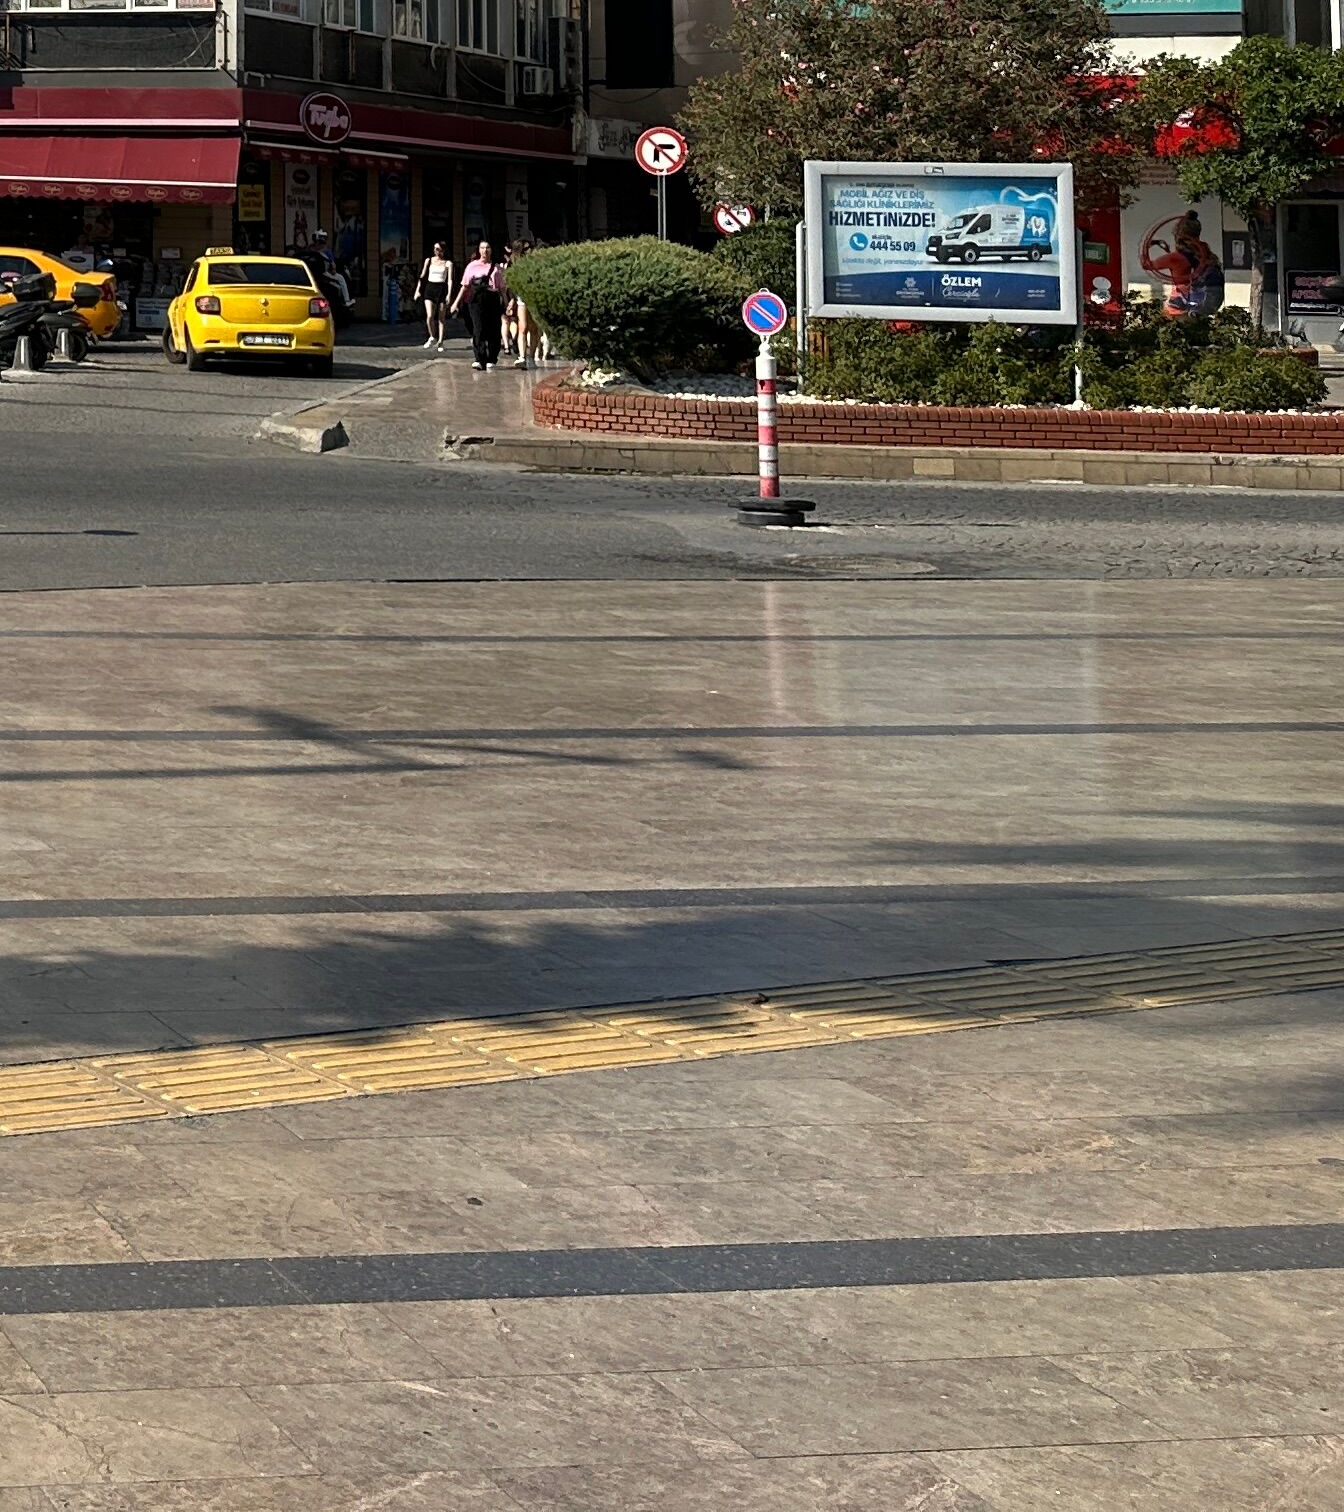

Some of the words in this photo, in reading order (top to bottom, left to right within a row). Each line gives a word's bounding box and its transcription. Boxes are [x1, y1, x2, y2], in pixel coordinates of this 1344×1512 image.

[895, 190, 907, 198] VE
[829, 211, 936, 227] HİZMETİNİZDE!
[870, 240, 888, 251] 444
[890, 241, 902, 251] 55
[941, 274, 982, 287] ÖZLEM
